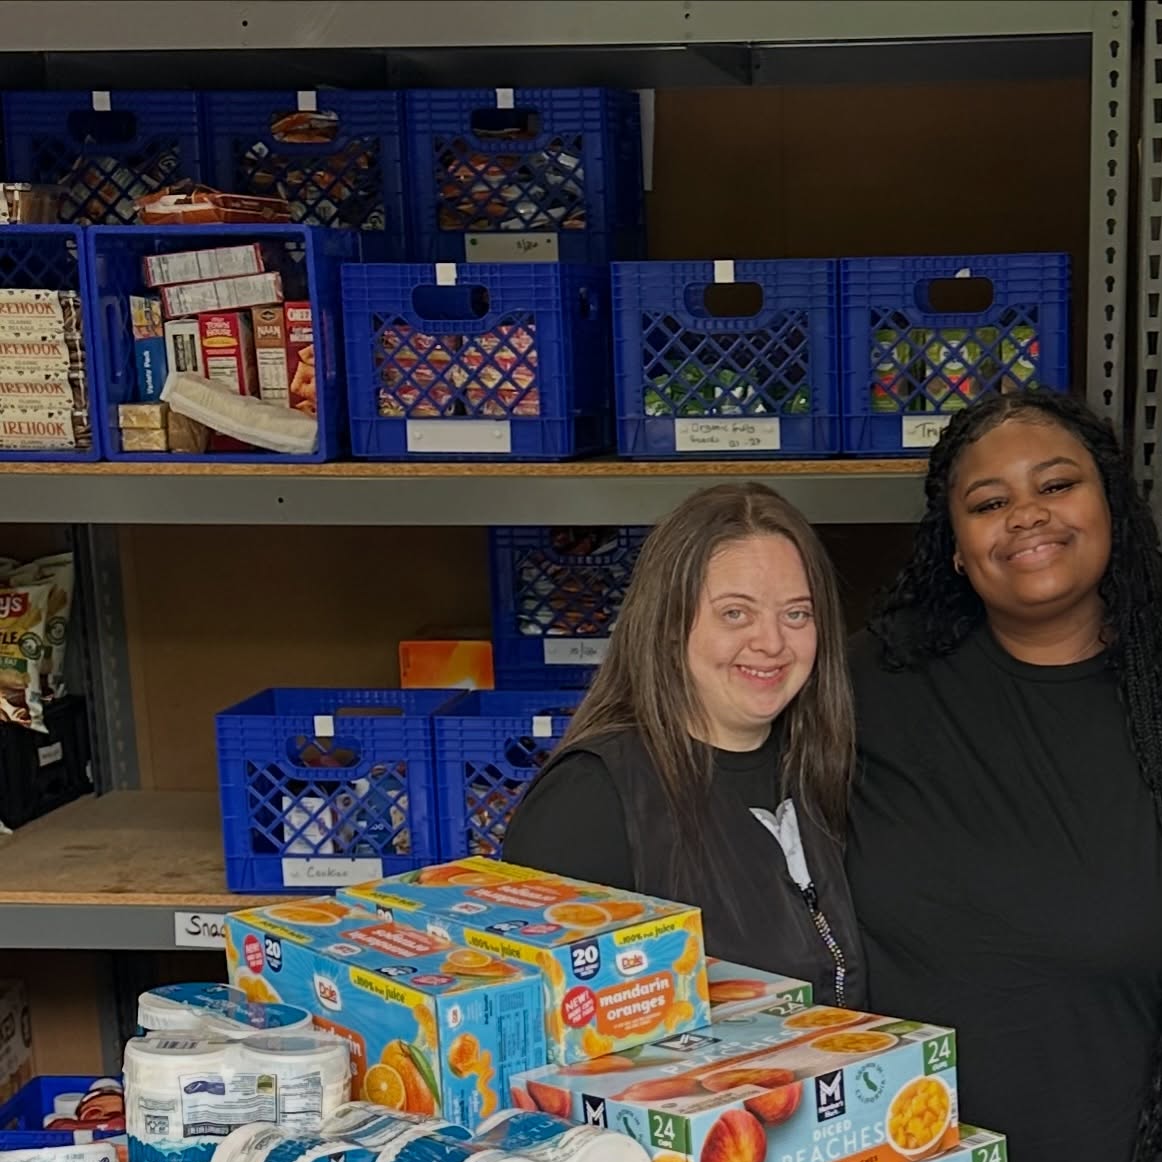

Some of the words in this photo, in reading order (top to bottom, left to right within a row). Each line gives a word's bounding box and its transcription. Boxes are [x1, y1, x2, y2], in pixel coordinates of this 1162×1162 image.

[265, 938, 281, 956] 20
[572, 944, 599, 964] 20
[621, 954, 645, 971] Dole
[599, 977, 671, 1008] mandarin
[606, 996, 666, 1021] oranges
[812, 1119, 853, 1143] DICED
